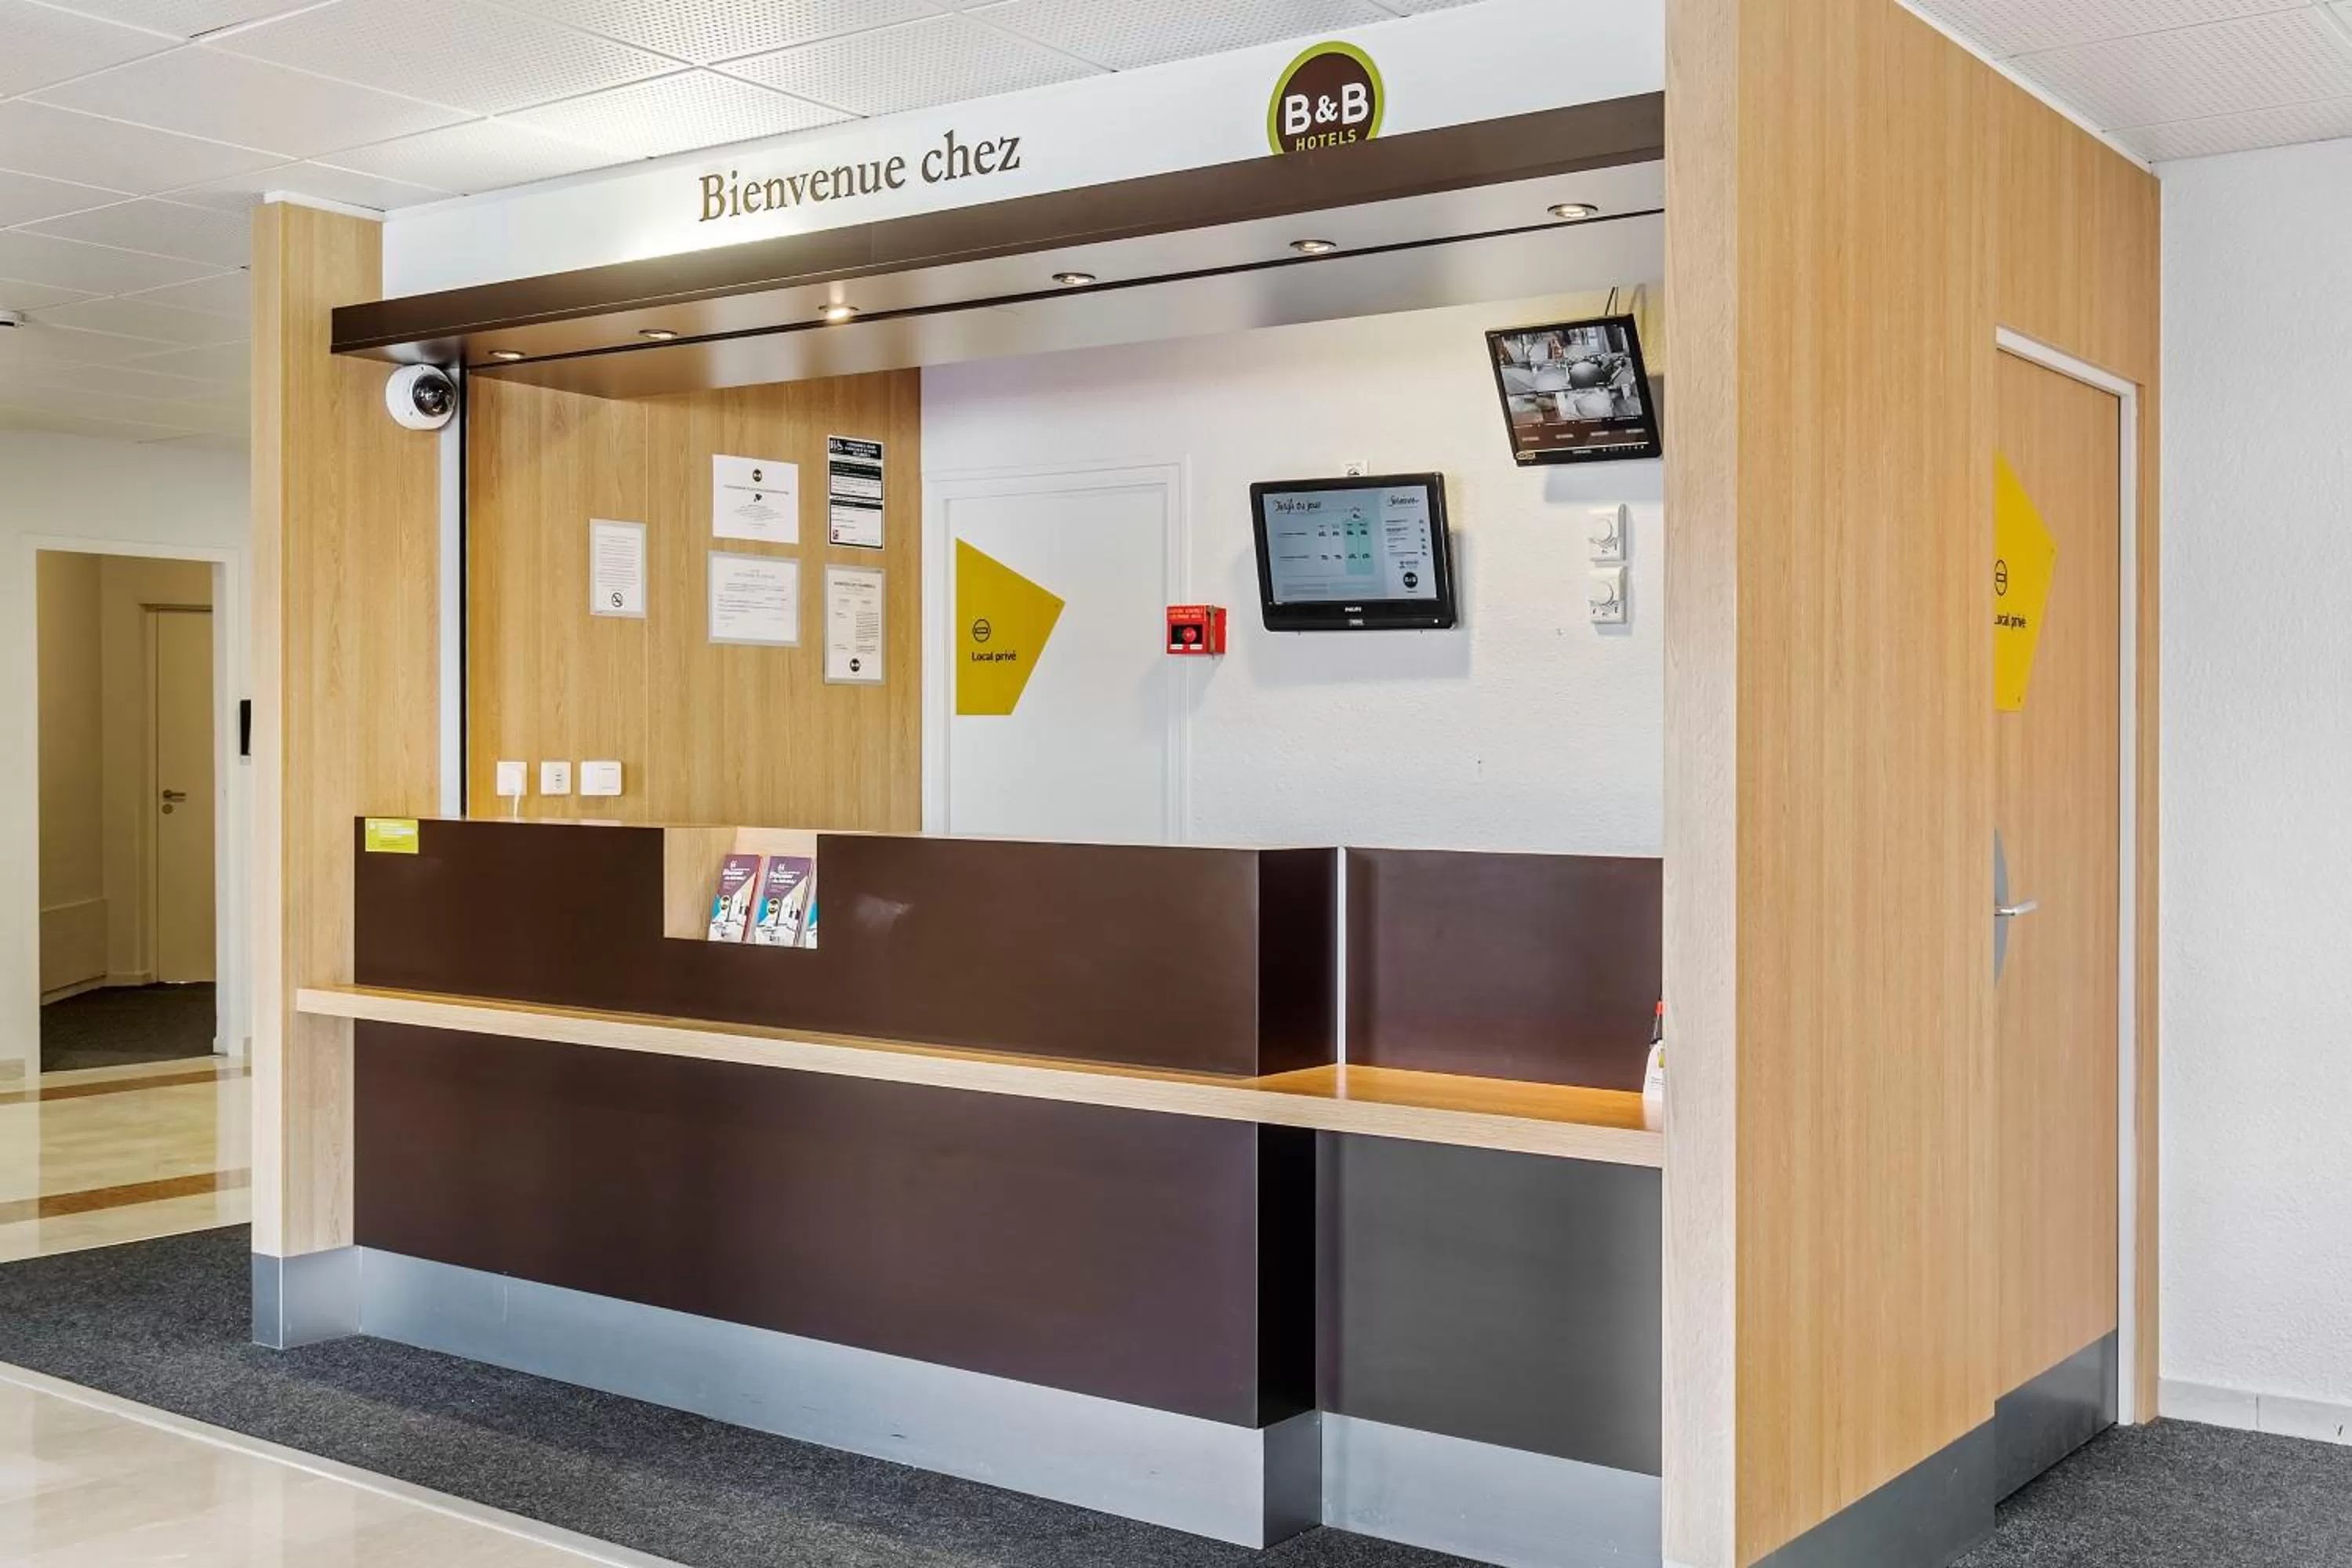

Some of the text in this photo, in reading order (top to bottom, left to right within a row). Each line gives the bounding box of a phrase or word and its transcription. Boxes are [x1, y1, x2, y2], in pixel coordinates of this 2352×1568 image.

[1285, 82, 1369, 136] B&B
[1295, 129, 1357, 151] HOTELS
[699, 129, 1021, 222] Bienvenue chez
[971, 649, 1017, 662] Local privé
